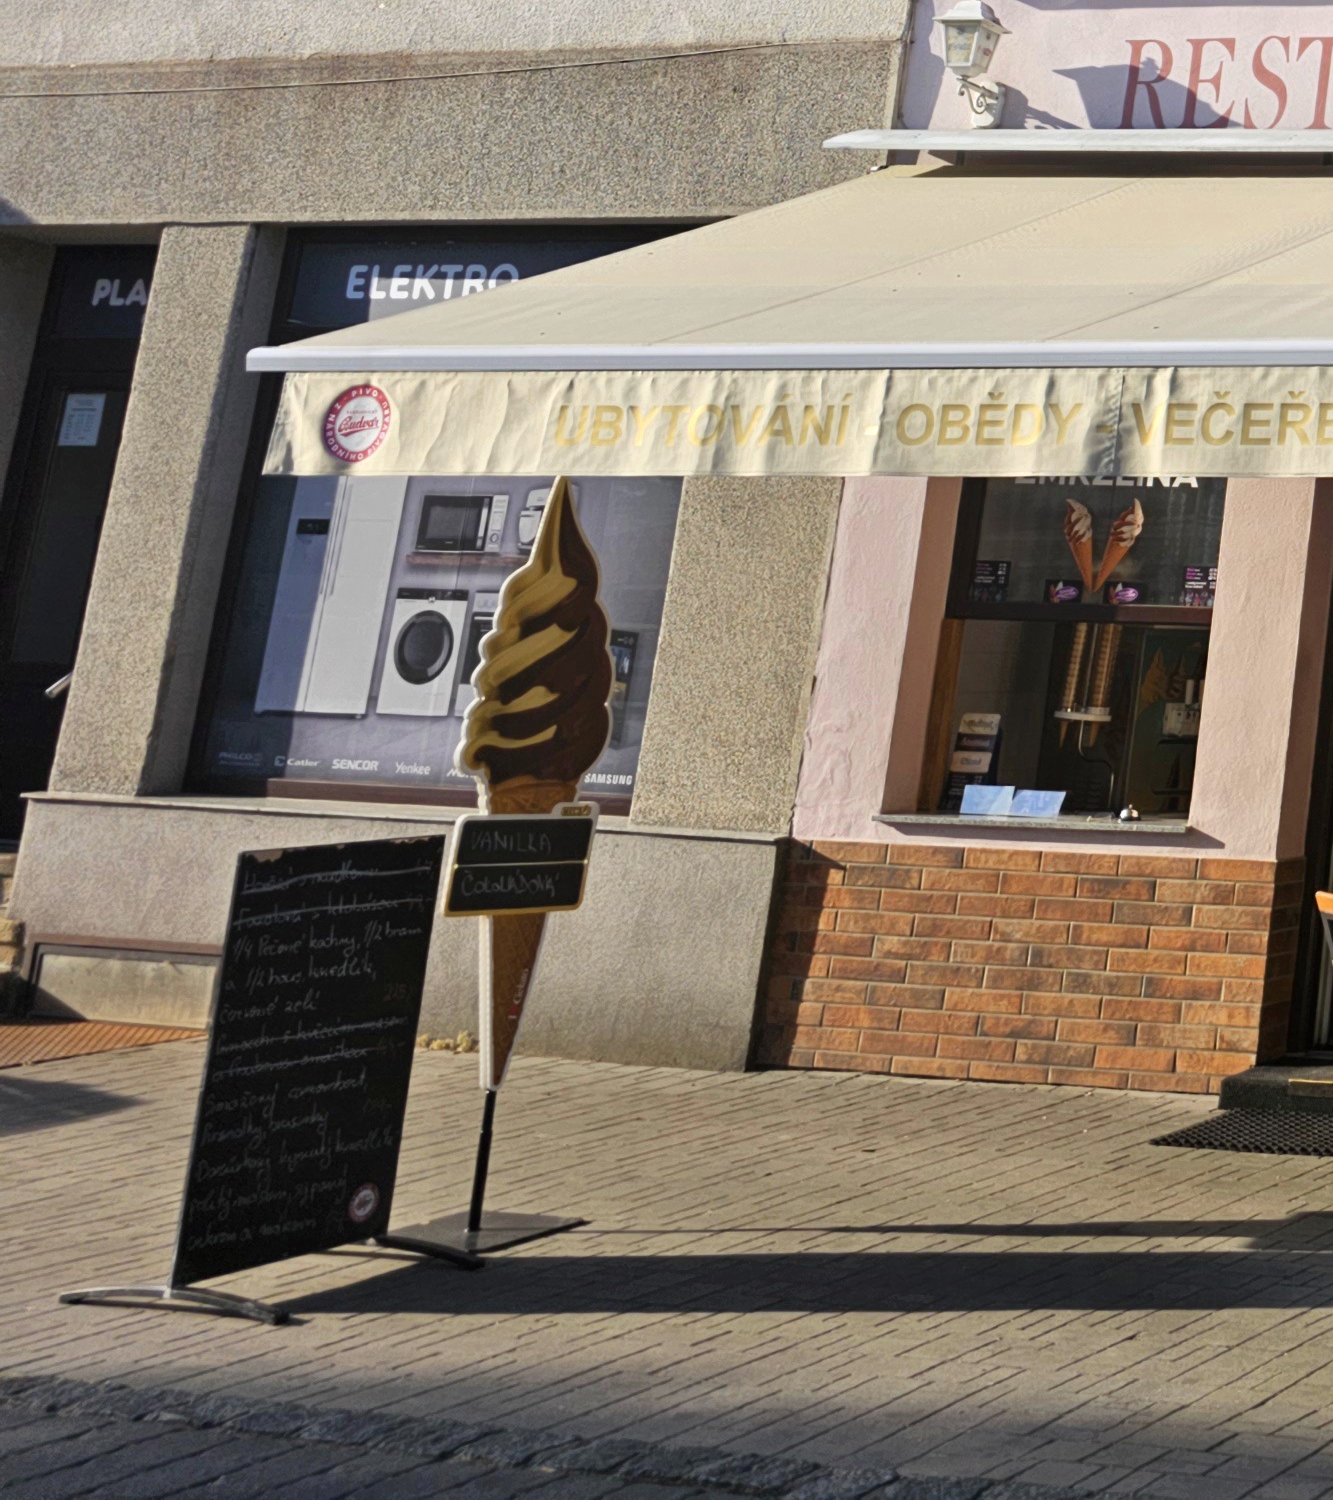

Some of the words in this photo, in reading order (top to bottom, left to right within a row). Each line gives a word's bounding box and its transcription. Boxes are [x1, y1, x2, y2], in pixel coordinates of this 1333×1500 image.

[338, 414, 380, 435] Budvar
[553, 392, 853, 447] UBYTOVÁNÍ
[895, 391, 1084, 446] OBĚDY
[331, 758, 379, 771] SENCOR
[395, 761, 431, 775] Yenkee
[584, 772, 633, 785] SAMSUNG
